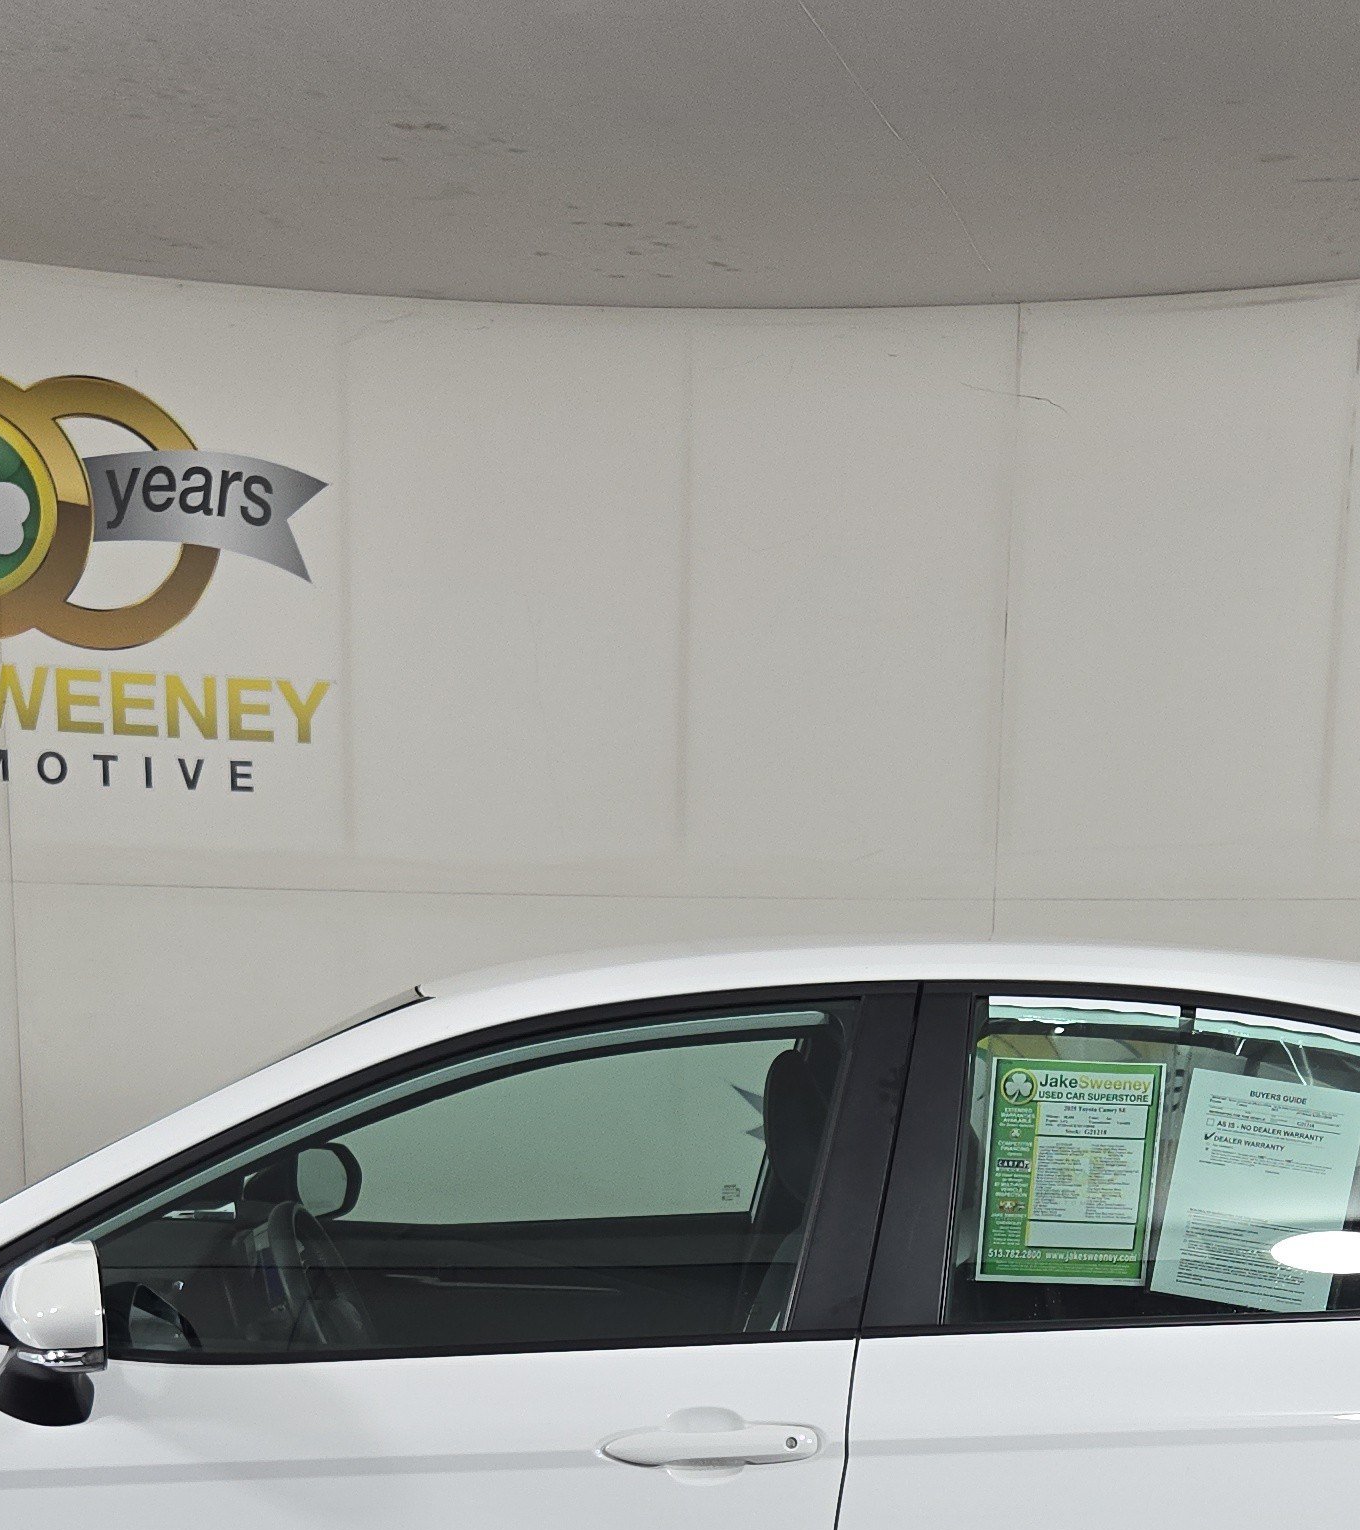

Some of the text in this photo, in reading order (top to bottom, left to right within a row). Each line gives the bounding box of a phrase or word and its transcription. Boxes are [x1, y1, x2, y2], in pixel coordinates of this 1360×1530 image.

[106, 464, 272, 529] years
[1038, 1091, 1149, 1102] USED CAR SUPERSTORE
[1250, 1090, 1308, 1105] BUYERS GUIDE
[1253, 1125, 1282, 1136] DEALER
[1283, 1130, 1324, 1142] WARRANTY
[1214, 1135, 1242, 1145] DEALER
[1244, 1139, 1285, 1152] WARRANTY
[1045, 1252, 1137, 1264] www.jakesweeney.com
